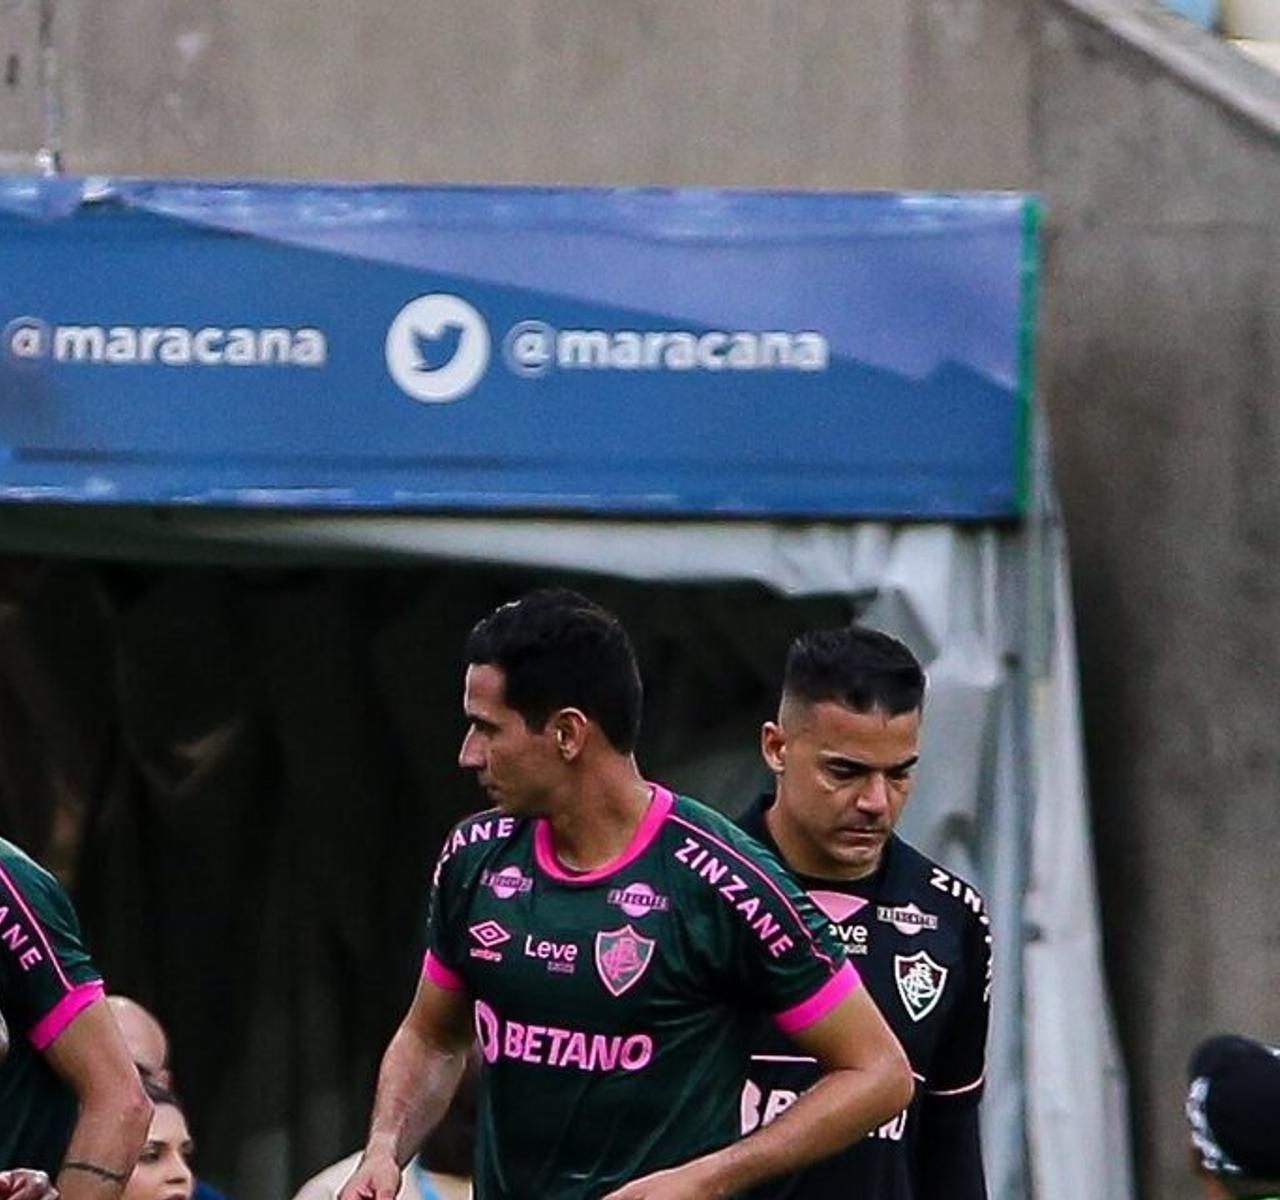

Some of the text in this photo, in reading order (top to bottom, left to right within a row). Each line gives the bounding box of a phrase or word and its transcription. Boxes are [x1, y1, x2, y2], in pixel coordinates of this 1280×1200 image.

[5, 317, 327, 366] @maracana
[506, 322, 829, 376] @maracana
[674, 838, 794, 958] ZINZANE
[525, 935, 578, 961] Leve
[504, 1021, 654, 1072] BETANO
